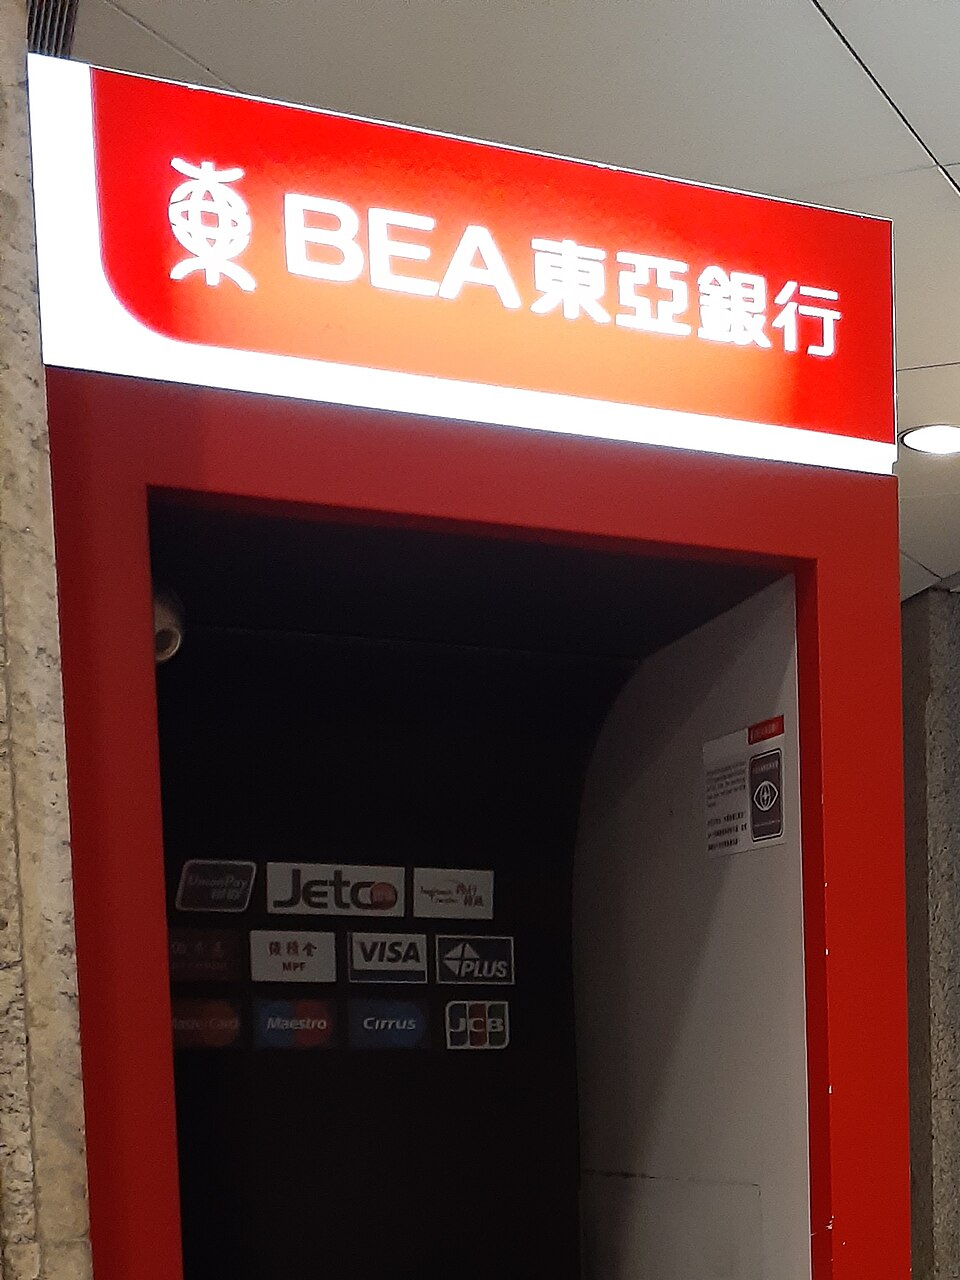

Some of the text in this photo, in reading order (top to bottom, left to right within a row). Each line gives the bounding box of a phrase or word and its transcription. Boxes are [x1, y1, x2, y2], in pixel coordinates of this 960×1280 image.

[284, 192, 843, 359] BEA 東亞銀行
[359, 941, 420, 963] VISA
[282, 961, 306, 972] MPF
[460, 960, 508, 979] PLUS
[267, 1017, 328, 1031] Maestro
[363, 1016, 416, 1031] Cirrus
[449, 1017, 505, 1033] JCB
